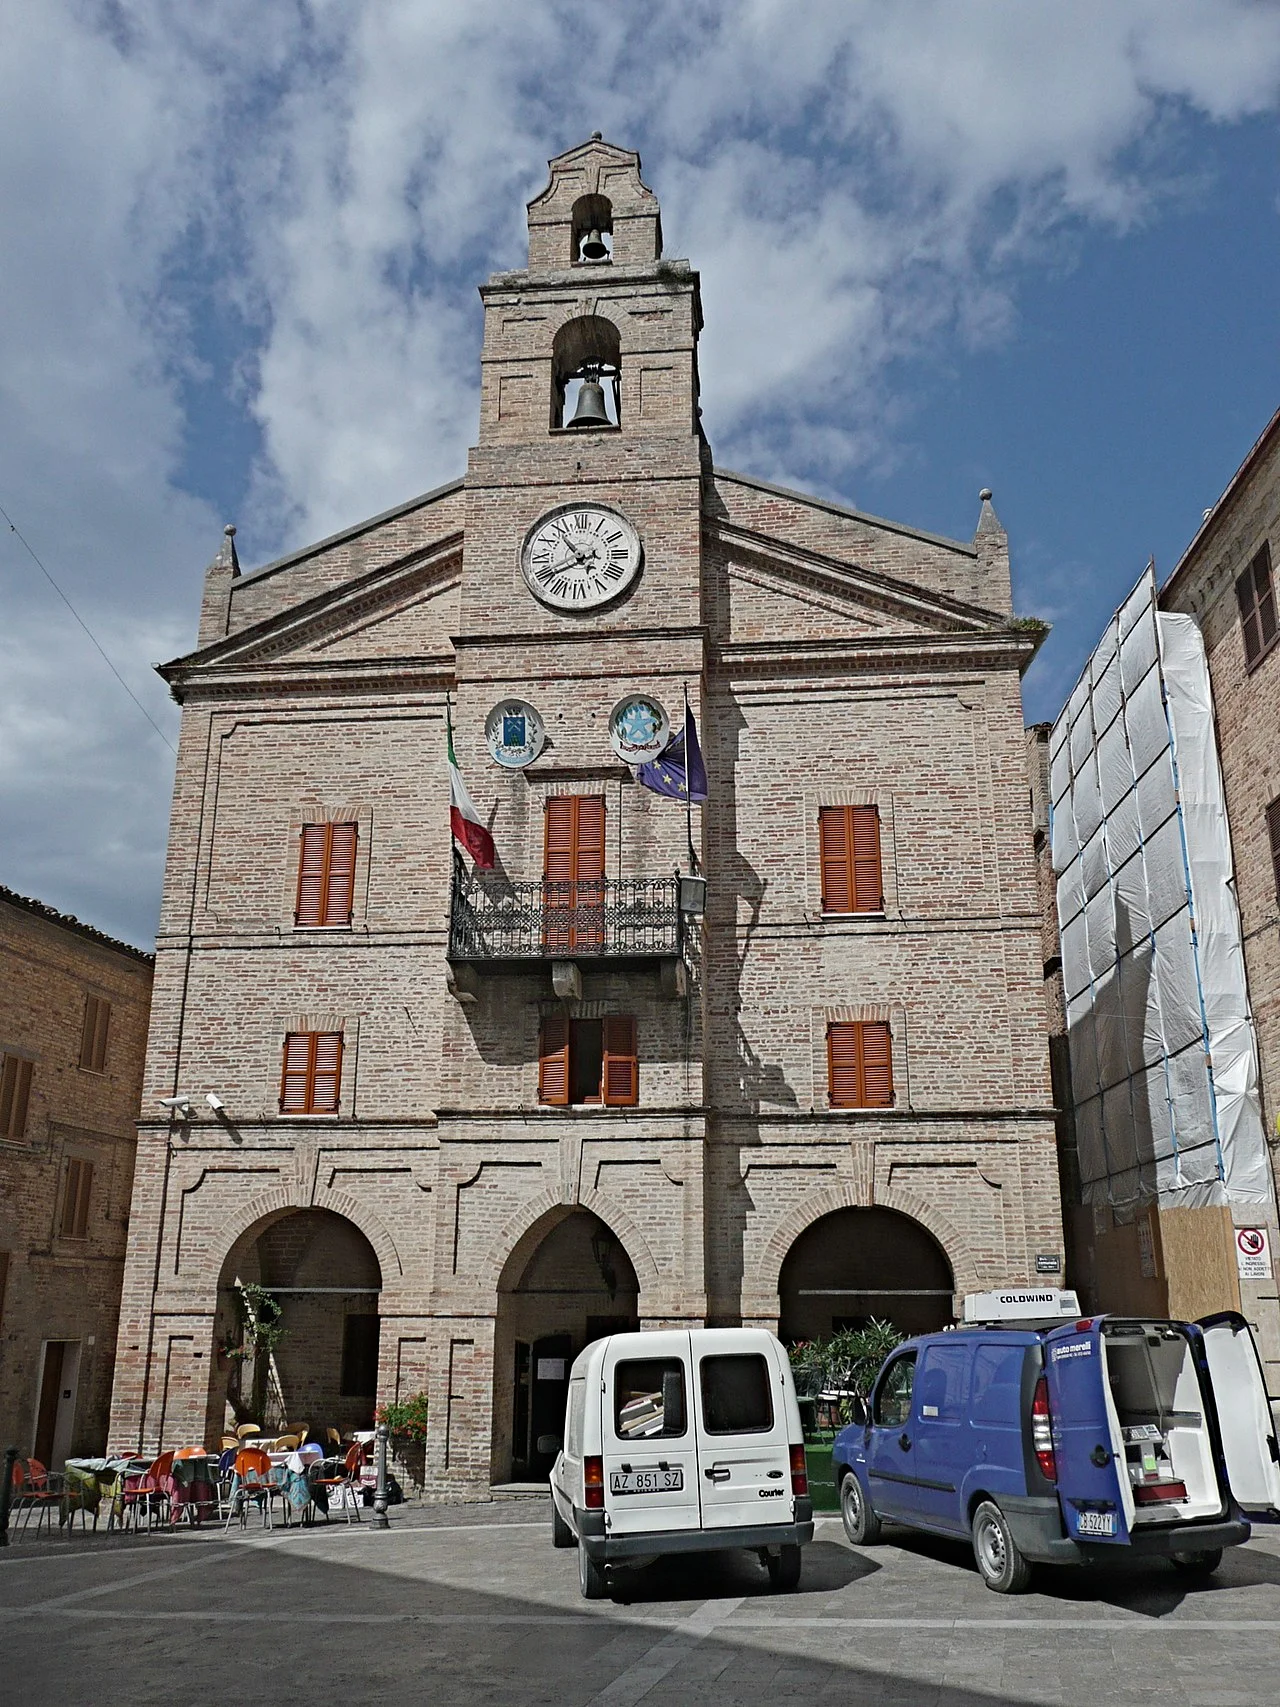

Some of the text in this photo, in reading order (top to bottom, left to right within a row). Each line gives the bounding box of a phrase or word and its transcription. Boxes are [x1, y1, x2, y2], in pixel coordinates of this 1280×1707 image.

[551, 518, 570, 535] XI
[574, 514, 588, 529] XII
[595, 518, 605, 532] I
[537, 533, 556, 548] X
[605, 530, 624, 543] II
[532, 552, 550, 563] IX
[611, 549, 629, 559] III
[603, 562, 625, 581] IIII
[549, 578, 568, 598] VII
[572, 583, 587, 600] VI
[594, 578, 608, 595] V
[1000, 1294, 1053, 1303] COLDWIND
[614, 1472, 679, 1489] AZ 851 SZ
[758, 1488, 784, 1498] Courier
